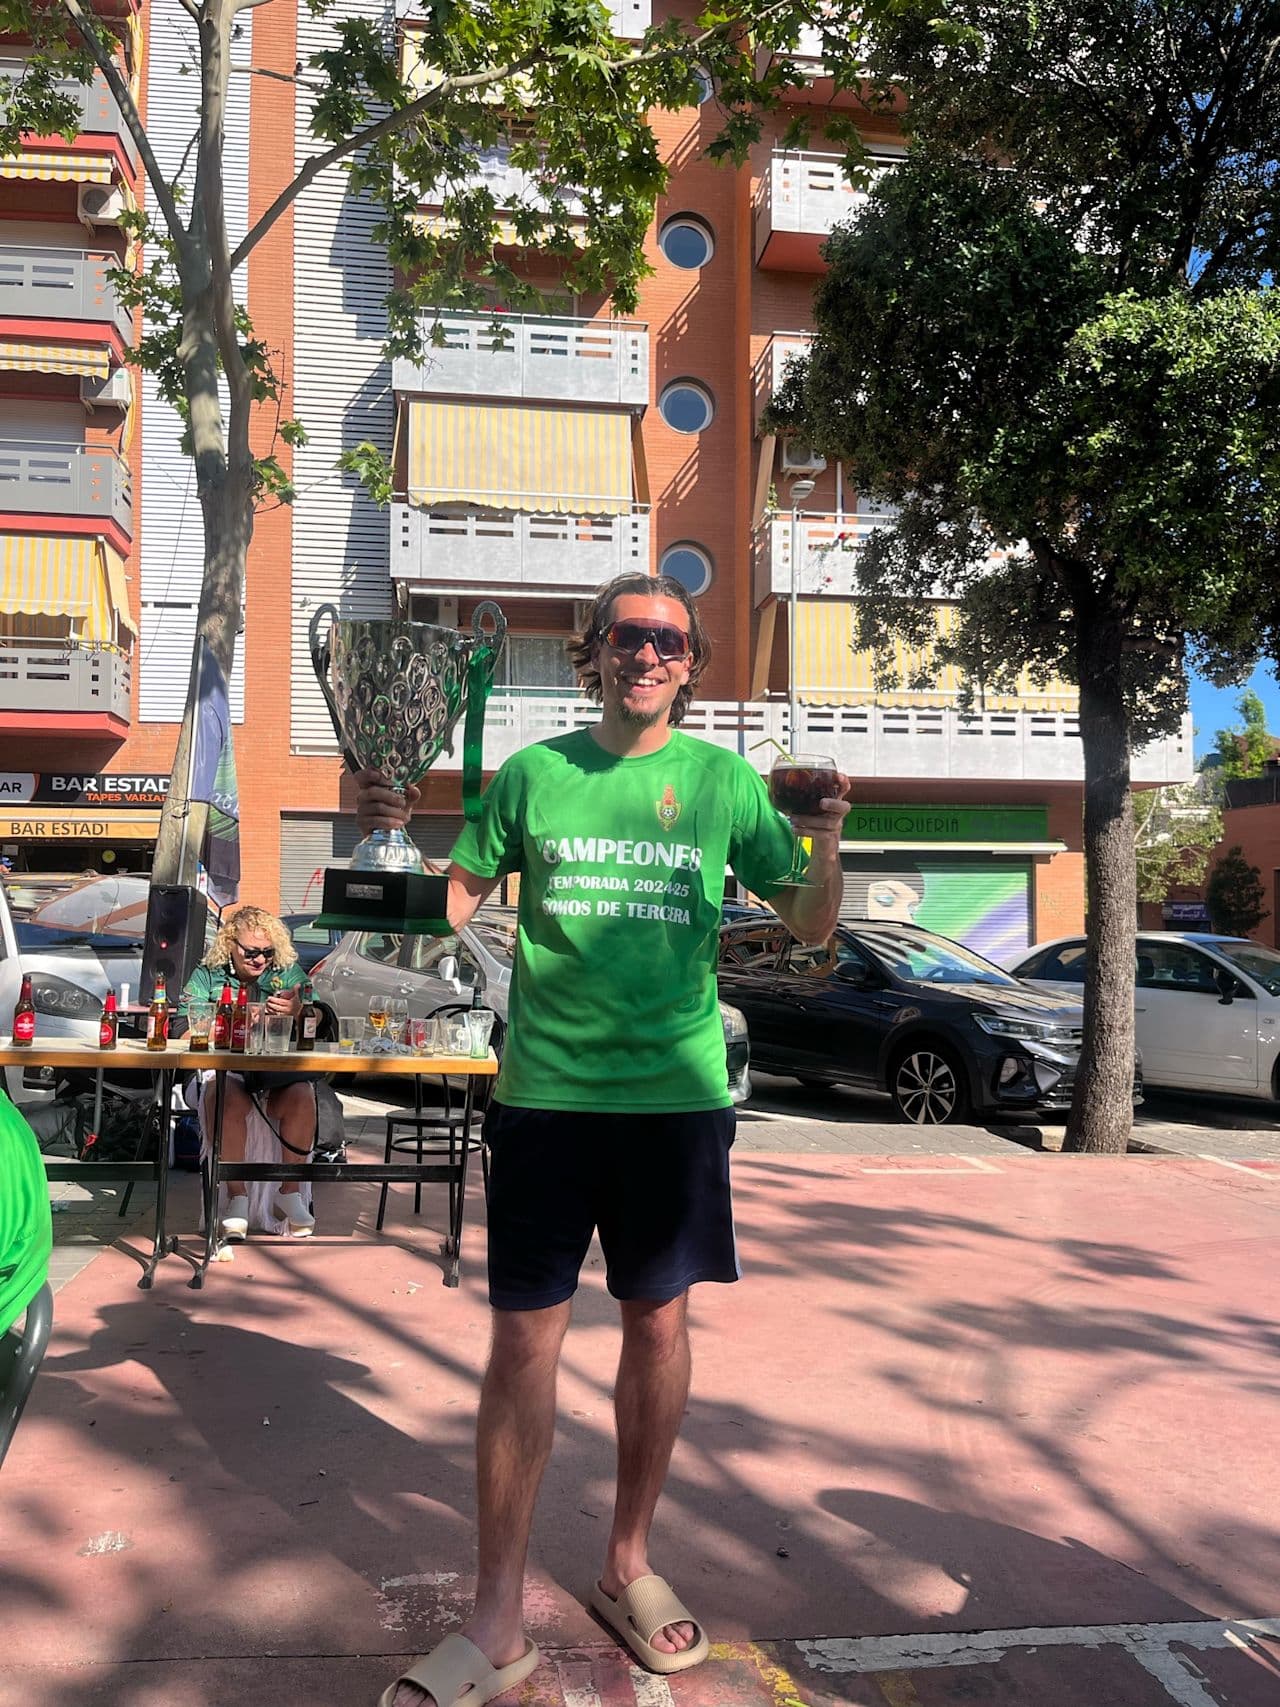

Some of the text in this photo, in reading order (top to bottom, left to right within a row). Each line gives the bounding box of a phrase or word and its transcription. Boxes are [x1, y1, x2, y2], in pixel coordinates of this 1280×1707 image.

[52, 776, 170, 793] BAR ESTAD
[86, 793, 122, 802] TAPES
[11, 822, 109, 836] BAR ESTADI
[857, 816, 959, 833] PELUQUERIA
[543, 837, 703, 872] CAMPEONES
[548, 875, 629, 892] TEMPORADA
[542, 898, 691, 926] SOMOS DE TERCERA
